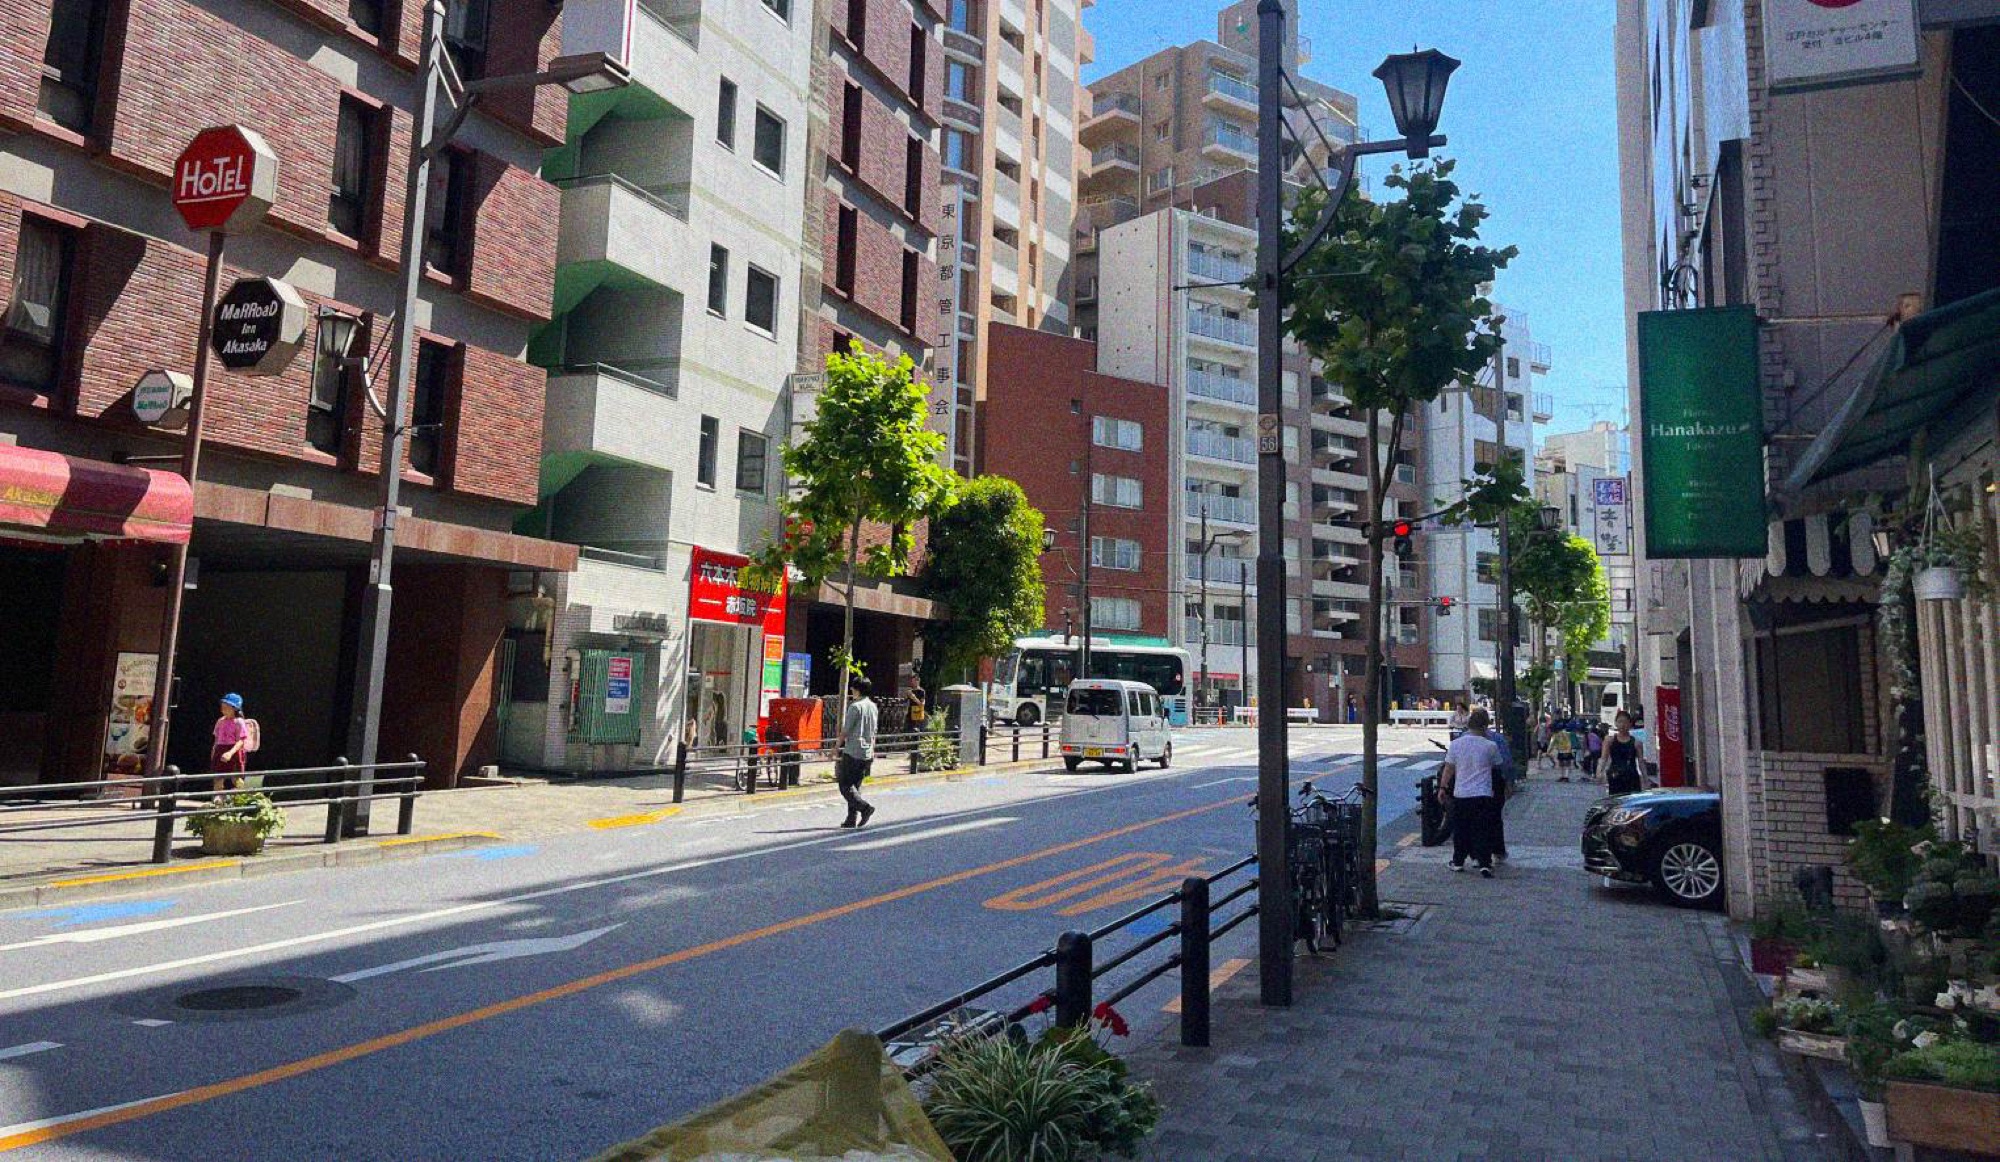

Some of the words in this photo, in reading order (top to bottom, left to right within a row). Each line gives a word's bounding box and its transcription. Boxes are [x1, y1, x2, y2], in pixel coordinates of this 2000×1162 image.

[241, 322, 257, 335] Inn
[935, 203, 955, 447] 東京都管工事会
[222, 338, 267, 354] Akasaka
[1651, 421, 1738, 438] Hanakazu
[1262, 437, 1275, 451] 56
